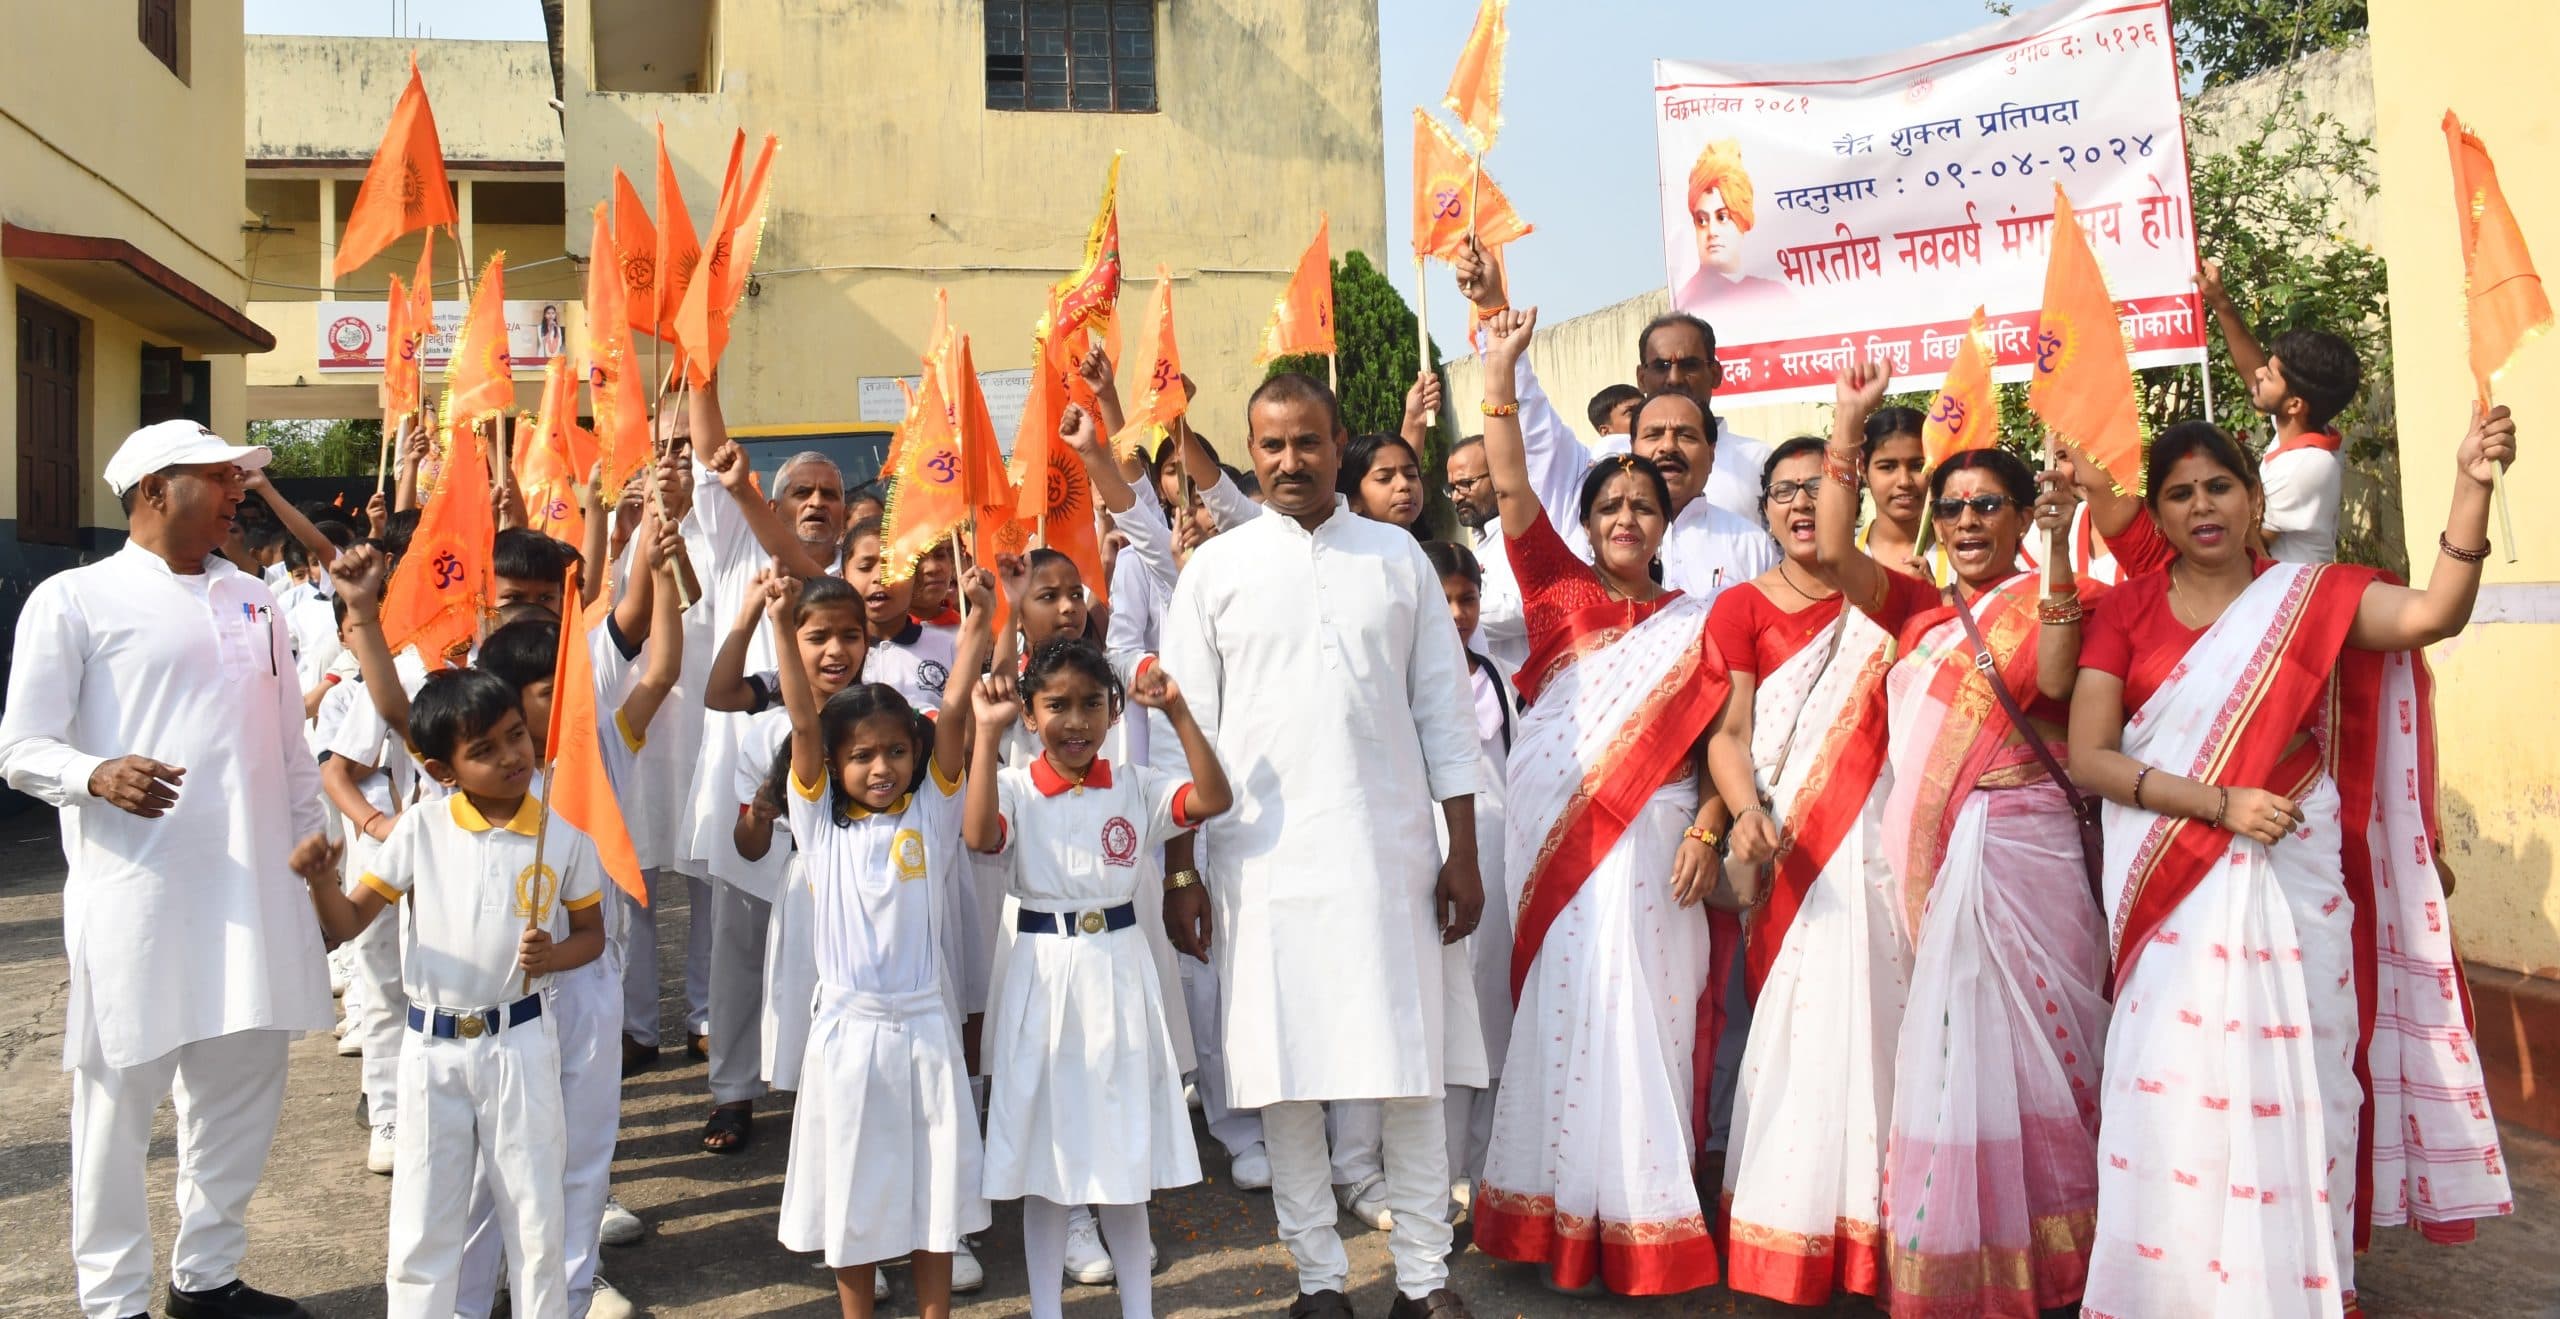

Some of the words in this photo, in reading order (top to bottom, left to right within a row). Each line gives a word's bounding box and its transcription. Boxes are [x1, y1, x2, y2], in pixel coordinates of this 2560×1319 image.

[2096, 22, 2158, 52] ५१२६
[1754, 96, 1810, 115] २०८१
[1975, 99, 2080, 137] प्रतिपदा
[1775, 177, 1878, 214] तदनुसार
[1776, 222, 1882, 286] भारतीय
[1893, 201, 1982, 273] नववर्ष
[1996, 201, 2123, 260] मंगमय
[1780, 338, 1856, 377] सरस्वती
[1864, 334, 1912, 374] शिशु
